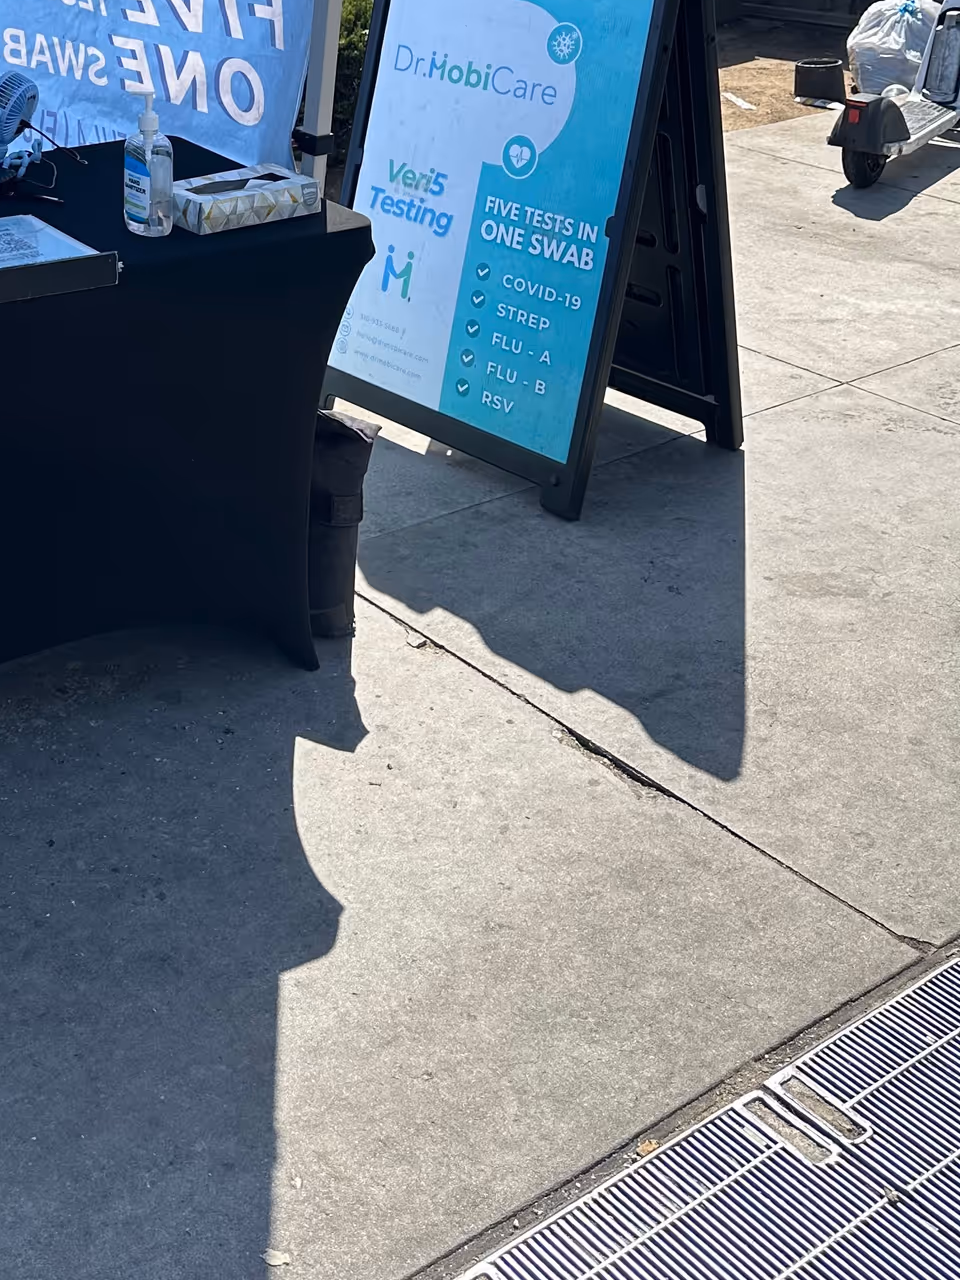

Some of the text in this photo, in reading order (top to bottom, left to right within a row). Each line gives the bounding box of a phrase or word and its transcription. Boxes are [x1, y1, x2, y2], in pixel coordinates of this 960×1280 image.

[394, 44, 557, 106] Dr.MobiCare
[388, 158, 449, 196] Veri5
[370, 185, 454, 238] Testing
[484, 195, 599, 243] FIVE TESTS IN
[480, 220, 594, 271] ONE SWAB
[502, 274, 582, 310] COVID-19
[496, 303, 550, 330] STREP
[491, 332, 523, 354] FLU
[538, 350, 551, 365] A
[486, 362, 518, 384] FLU
[534, 379, 547, 395] B
[481, 391, 515, 413] RSV
